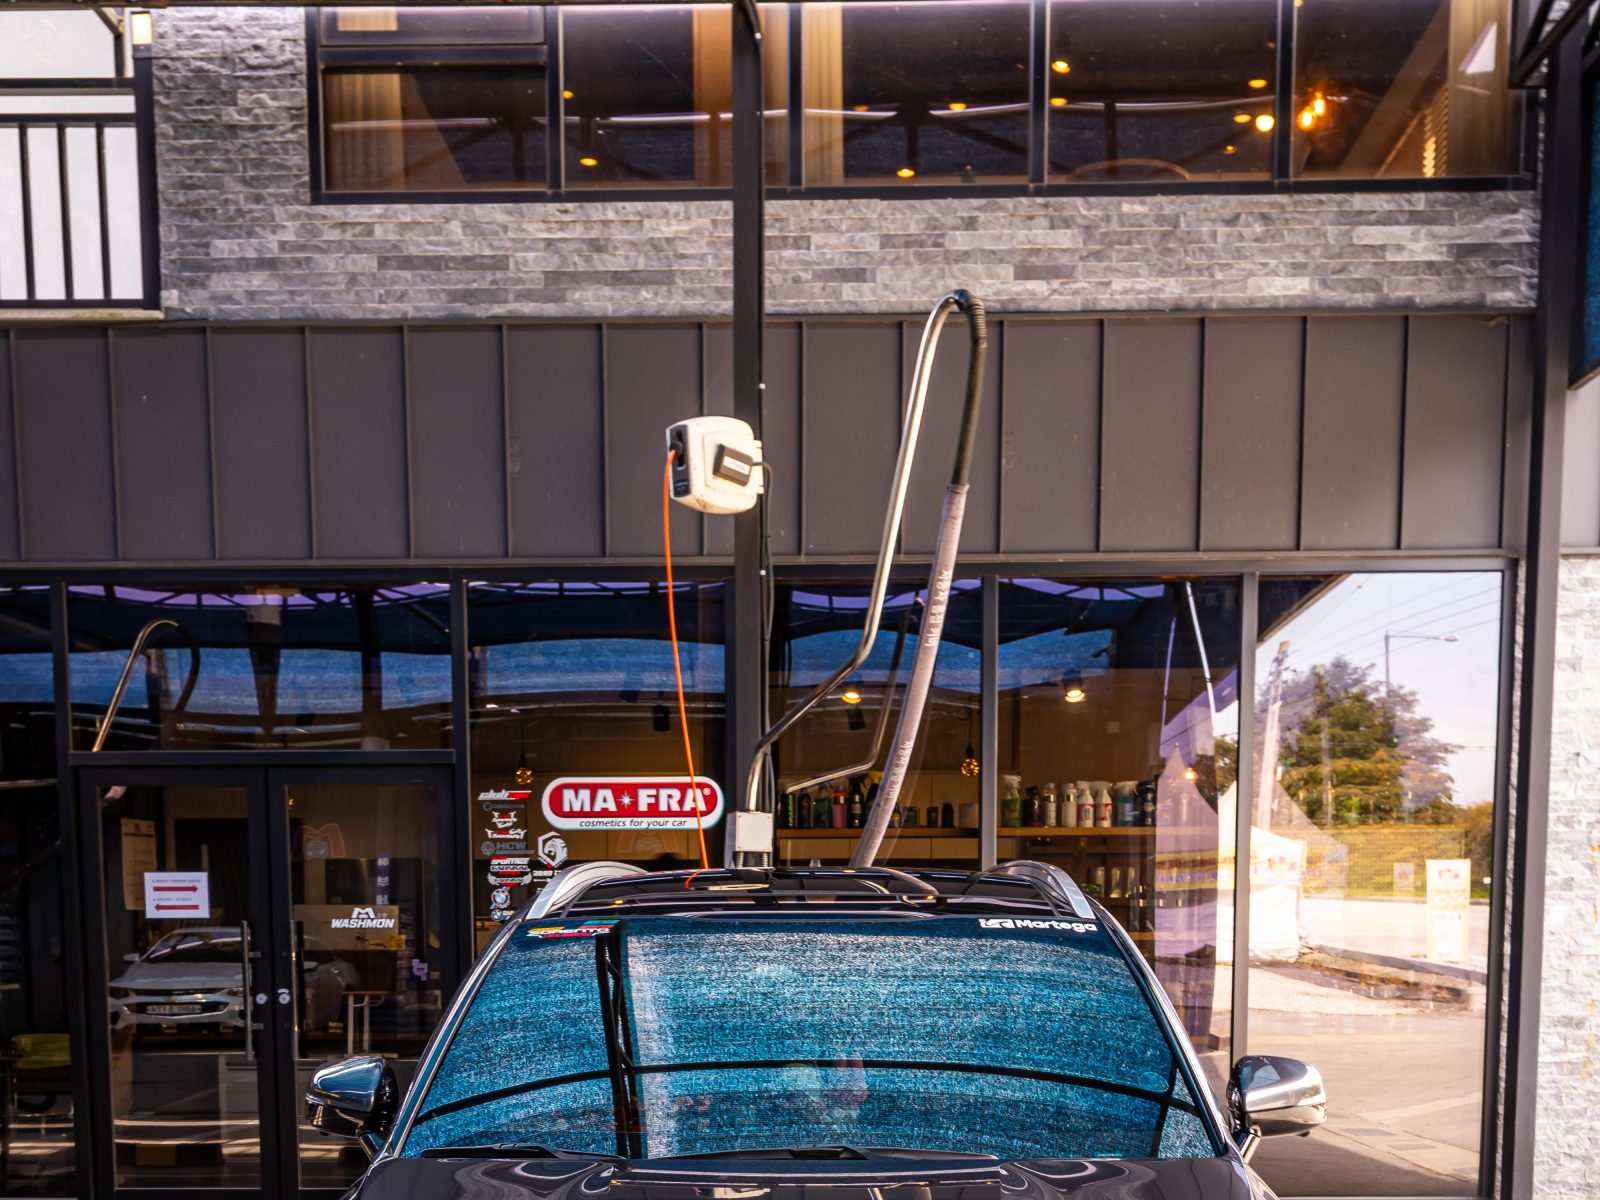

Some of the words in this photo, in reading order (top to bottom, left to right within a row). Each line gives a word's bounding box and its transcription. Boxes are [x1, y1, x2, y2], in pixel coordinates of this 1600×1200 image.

[579, 819, 626, 828] cosmetics
[629, 819, 644, 829] for
[645, 820, 668, 830] your
[671, 820, 687, 828] car
[496, 841, 527, 850] HCW
[331, 918, 395, 929] WASHMON
[1015, 919, 1098, 932] Martega
